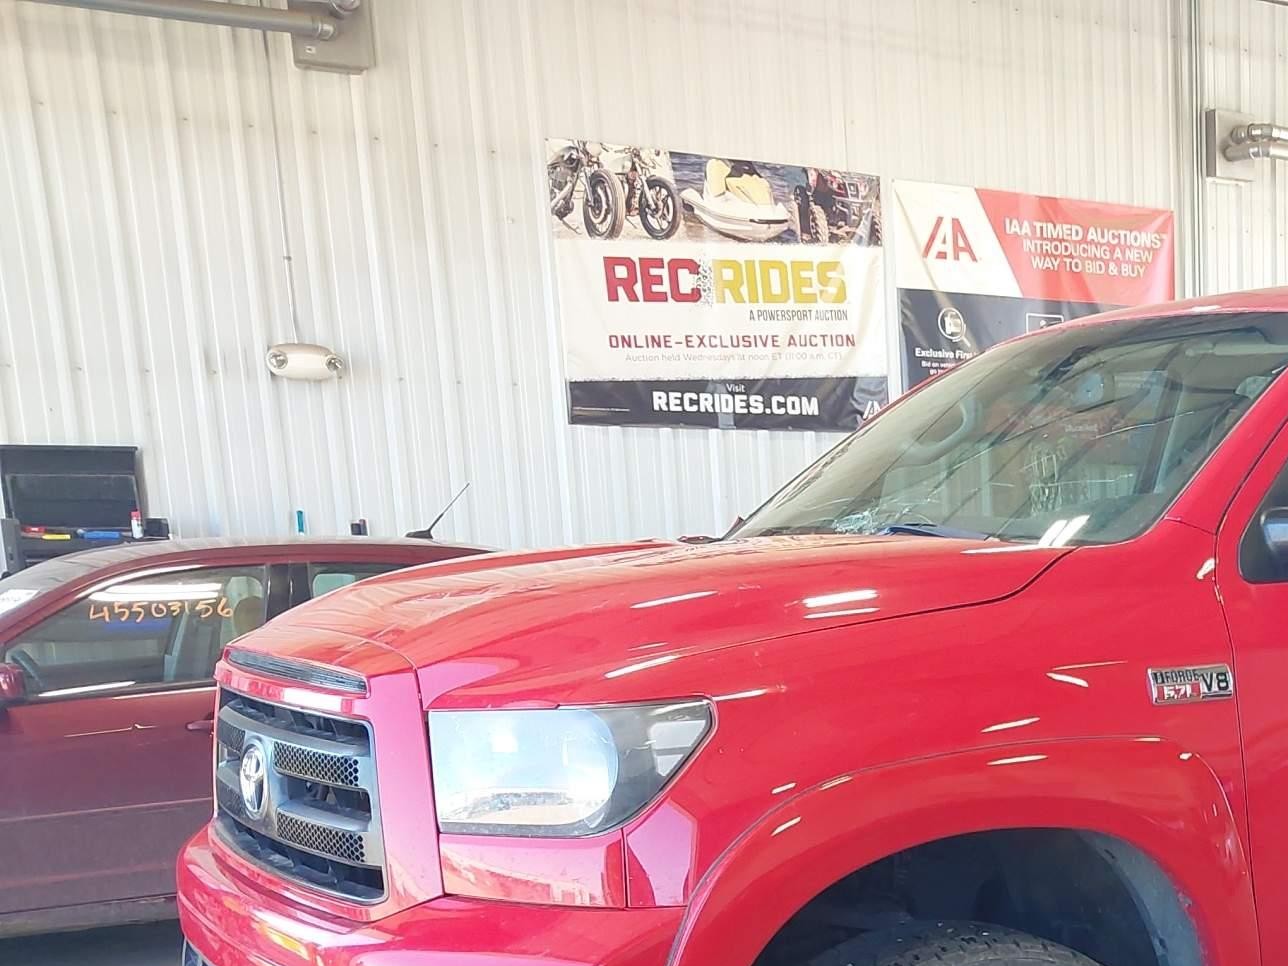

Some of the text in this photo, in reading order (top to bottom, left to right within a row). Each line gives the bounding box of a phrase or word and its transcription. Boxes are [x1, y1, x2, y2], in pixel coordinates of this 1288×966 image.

[1005, 217, 1031, 236] IAA
[1033, 221, 1083, 241] TIMED
[1023, 239, 1153, 263] INTRODUCING A NEW
[1031, 256, 1145, 278] WAY TO BID & BUY
[603, 256, 848, 304] REC RIDES
[749, 309, 848, 321] A POWERSPORT AUCTION
[609, 333, 856, 349] ONLINE-EXCLUSIVE AUCTION
[626, 353, 660, 362] Auction
[661, 352, 681, 362] held
[914, 346, 955, 359] Exclusive
[725, 383, 746, 393] Visit
[652, 391, 820, 416] RECRIDES.COM
[89, 597, 233, 623] 45503156
[1201, 671, 1230, 692] V8
